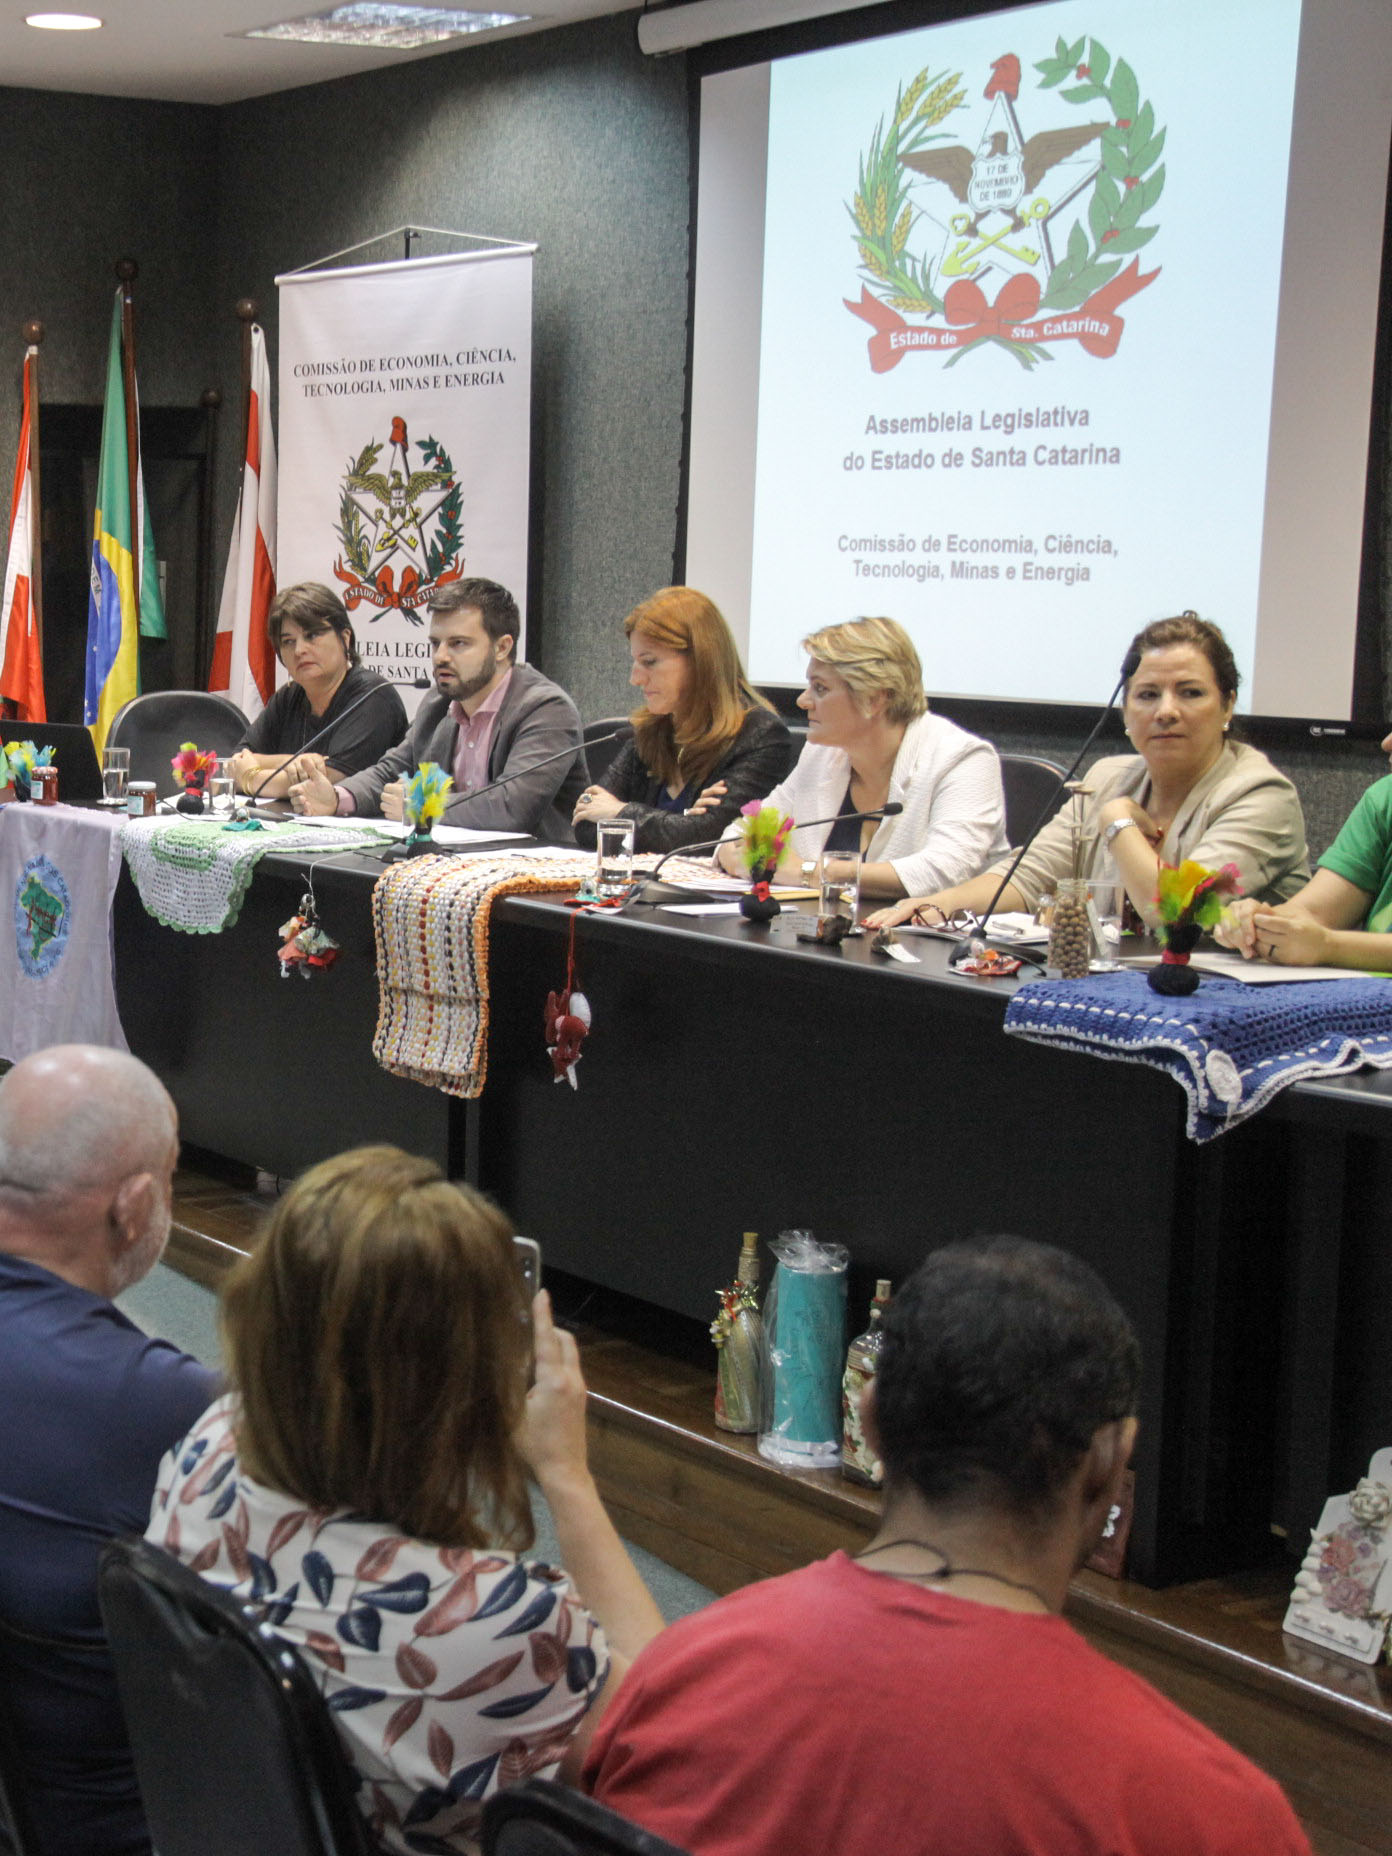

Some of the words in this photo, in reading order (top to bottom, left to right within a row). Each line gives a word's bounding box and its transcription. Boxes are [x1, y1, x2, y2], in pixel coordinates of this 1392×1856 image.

[890, 330, 937, 350] Estado
[940, 333, 957, 345] de
[1011, 325, 1038, 339] Sta.
[1043, 317, 1110, 336] Catarina
[293, 358, 356, 378] COMISSÃO
[359, 359, 376, 373] DE
[379, 353, 453, 371] ECONOMIA,
[456, 347, 516, 366] CIÊNCIA,
[302, 379, 386, 398] TECNOLOGIA,
[389, 376, 430, 391] MINAS
[433, 375, 441, 389] E
[445, 371, 505, 388] ENERGIA
[865, 411, 973, 435] Assembleia
[980, 405, 1090, 435] Legislativa
[843, 452, 865, 471] do
[871, 449, 935, 470] Estado
[941, 448, 964, 468] de
[971, 446, 1027, 467] Santa
[1033, 443, 1121, 466] Catarina
[838, 534, 916, 552] Comissão
[922, 535, 941, 552] de
[946, 534, 1038, 556] Economia,
[1044, 534, 1119, 558] Ciência,
[853, 559, 945, 583] Tecnologia,
[950, 560, 999, 579] Minas
[1005, 566, 1016, 580] e
[1022, 562, 1091, 586] Energia
[344, 587, 374, 600] ESTADO
[375, 594, 385, 605] DE
[356, 641, 390, 657] LEIA
[395, 642, 431, 658] LEGI
[387, 665, 428, 679] SANTA
